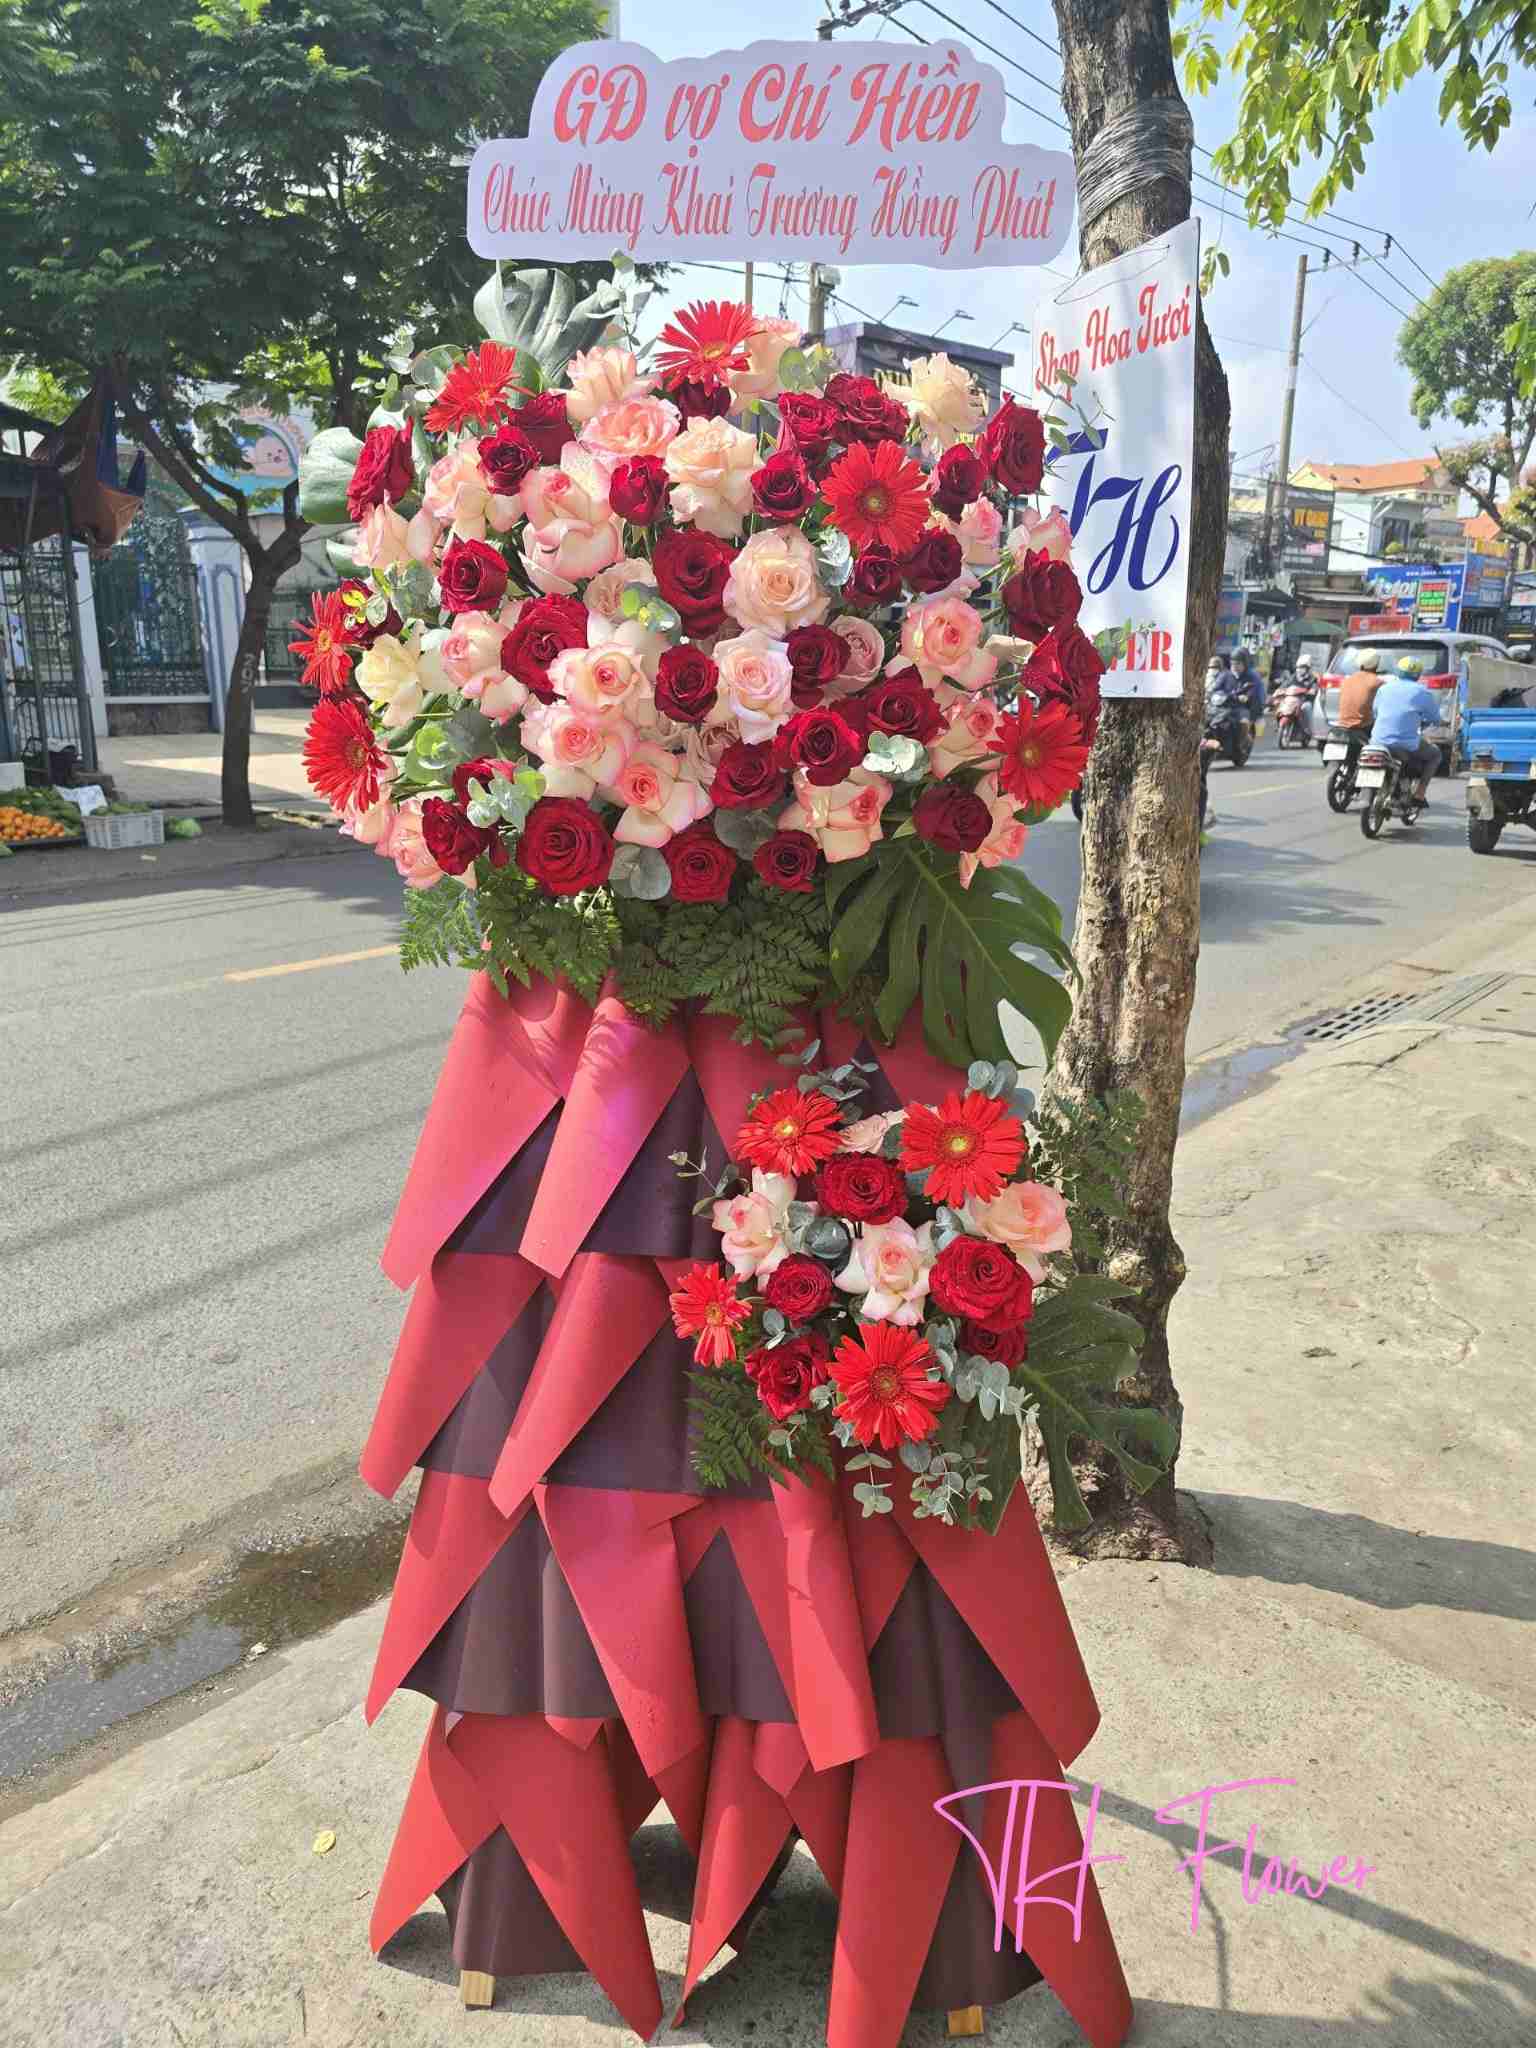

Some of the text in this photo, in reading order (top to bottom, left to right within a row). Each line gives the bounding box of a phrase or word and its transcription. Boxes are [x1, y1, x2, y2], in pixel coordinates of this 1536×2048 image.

[554, 63, 648, 148] GĐ
[738, 63, 833, 143] Chí
[845, 49, 982, 152] Hiền
[483, 161, 1057, 256] Chúc Mừng Khai Trương Hồng Phát
[1035, 330, 1080, 403] Shop
[1086, 304, 1131, 371] Hoa
[1137, 279, 1192, 353] Tươi
